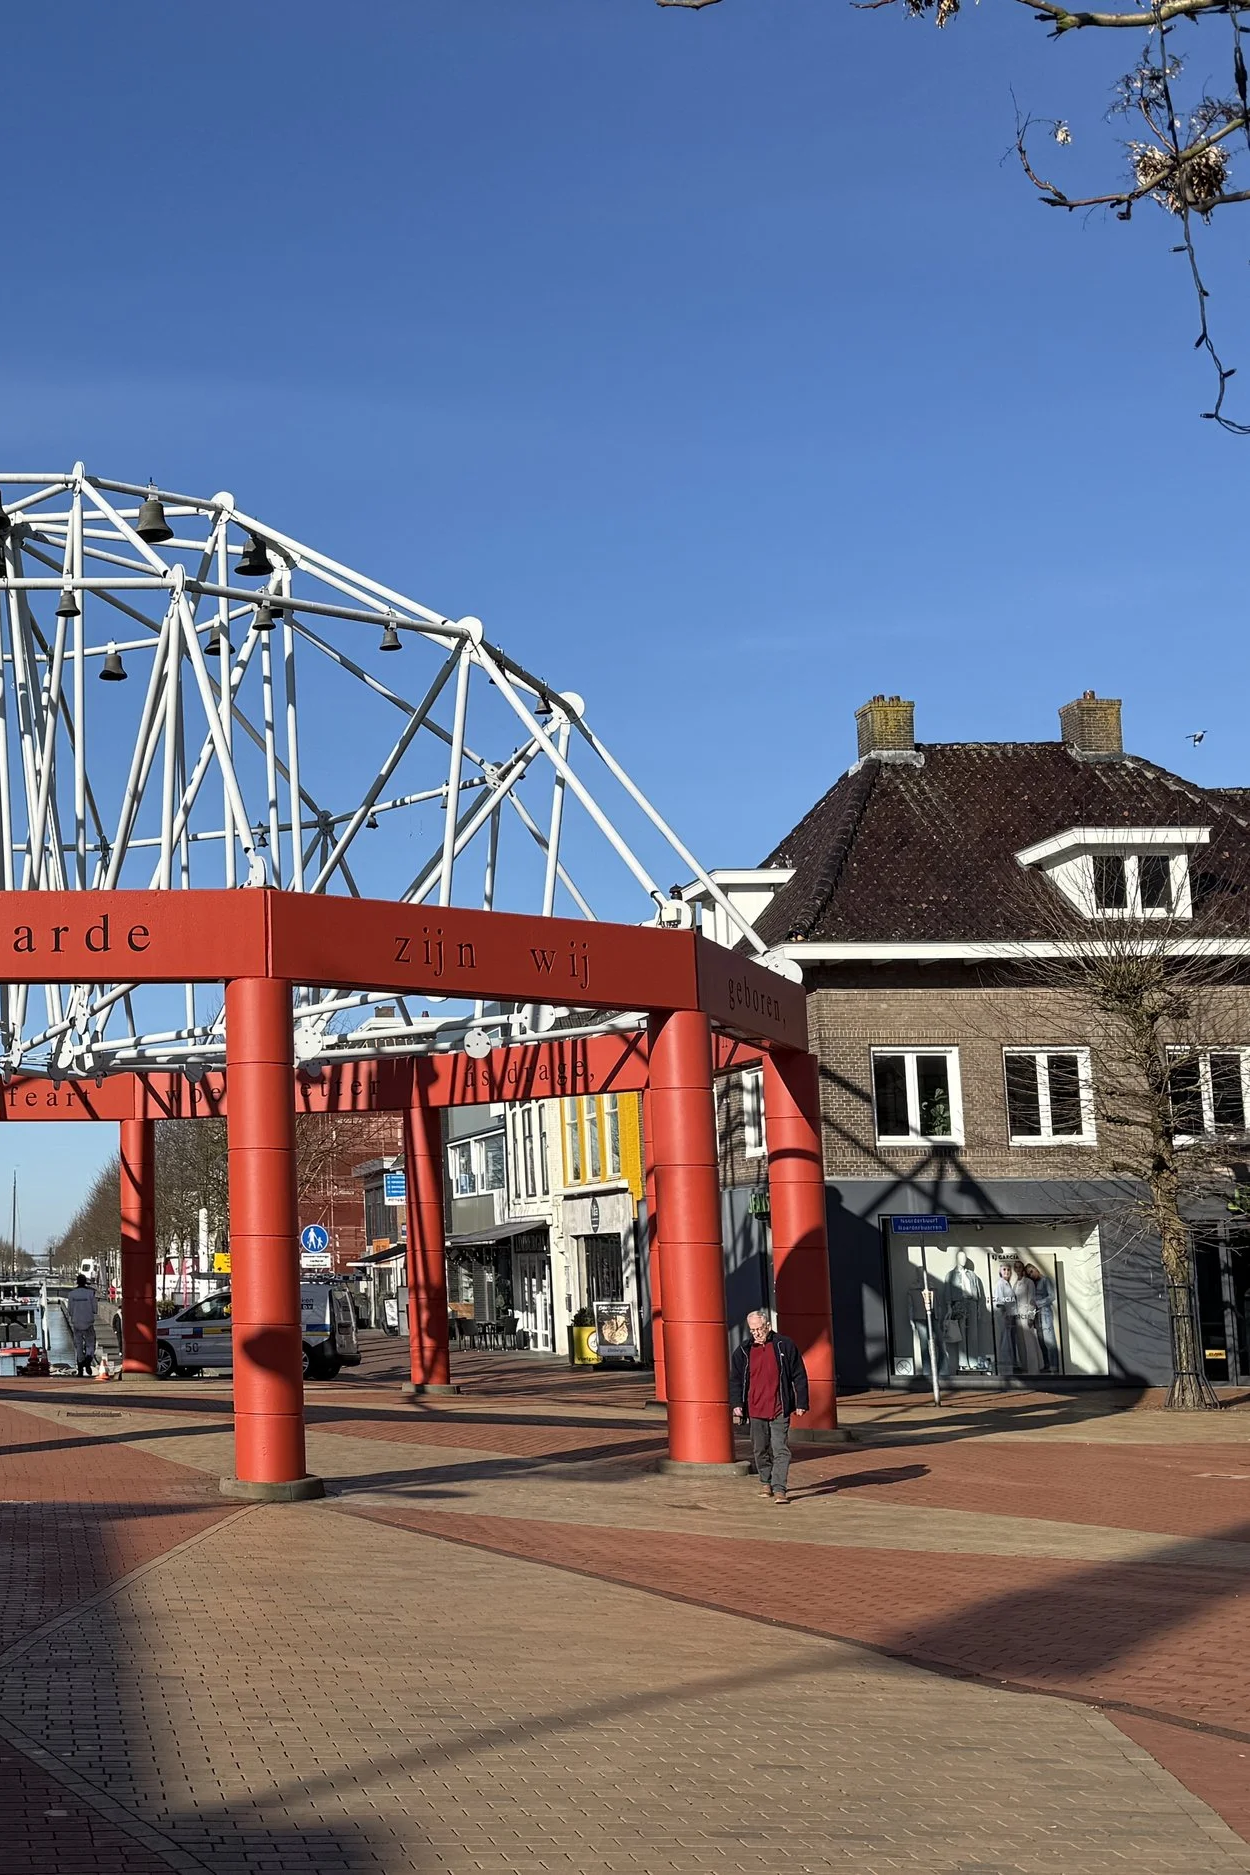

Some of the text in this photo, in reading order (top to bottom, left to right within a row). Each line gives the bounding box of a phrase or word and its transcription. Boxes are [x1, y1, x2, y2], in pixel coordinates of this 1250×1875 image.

[393, 926, 590, 990] zijn wij
[728, 975, 786, 1031] geboren,
[507, 1059, 595, 1086] drage,
[299, 1078, 381, 1099] etter
[185, 1342, 199, 1353] 50
